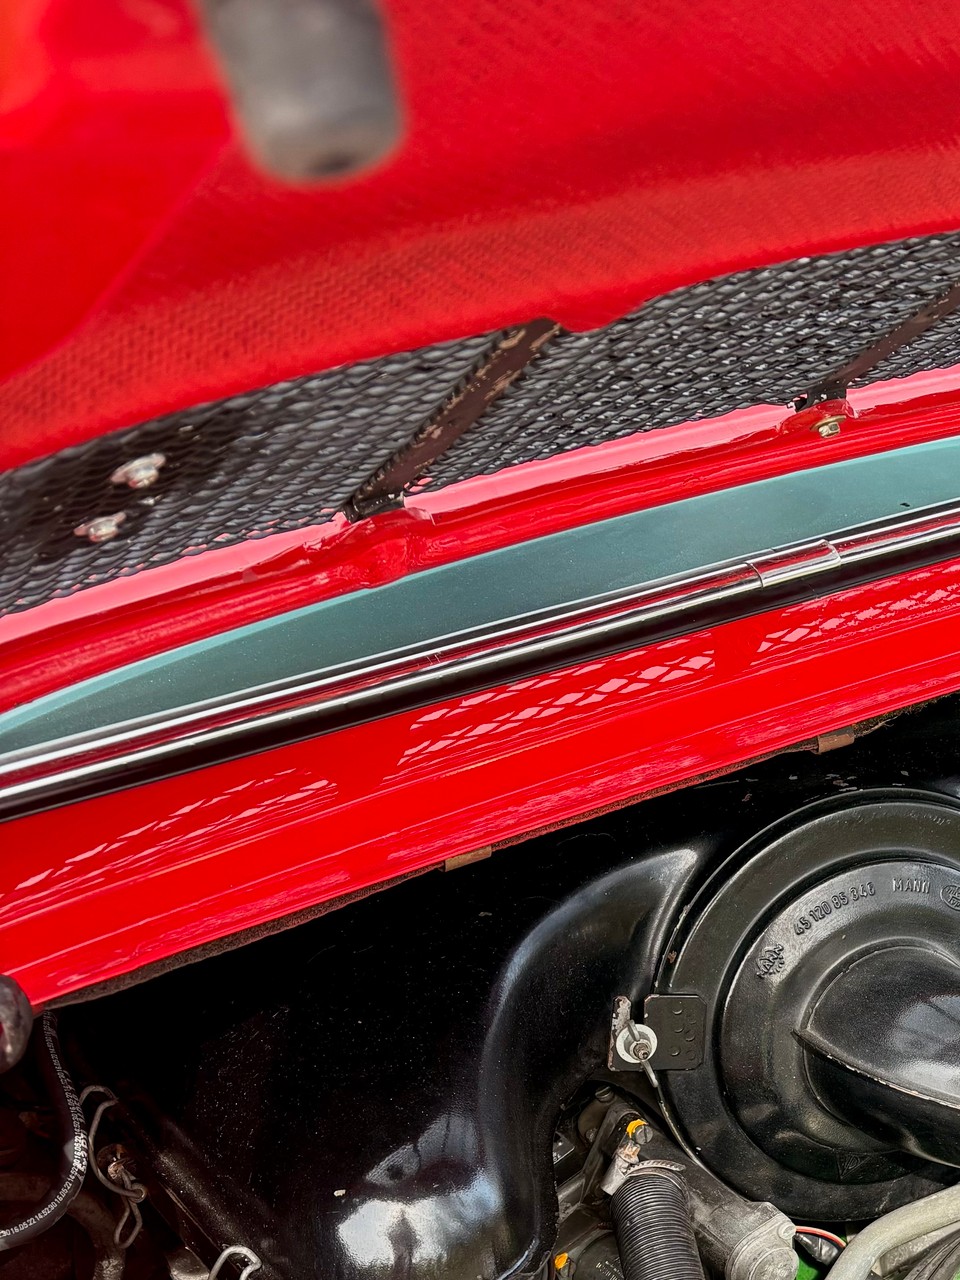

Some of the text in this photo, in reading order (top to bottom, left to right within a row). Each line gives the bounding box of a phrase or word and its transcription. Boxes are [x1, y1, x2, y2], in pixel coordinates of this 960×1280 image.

[891, 878, 931, 894] MANN
[809, 901, 832, 922] 120
[831, 892, 849, 910] 85
